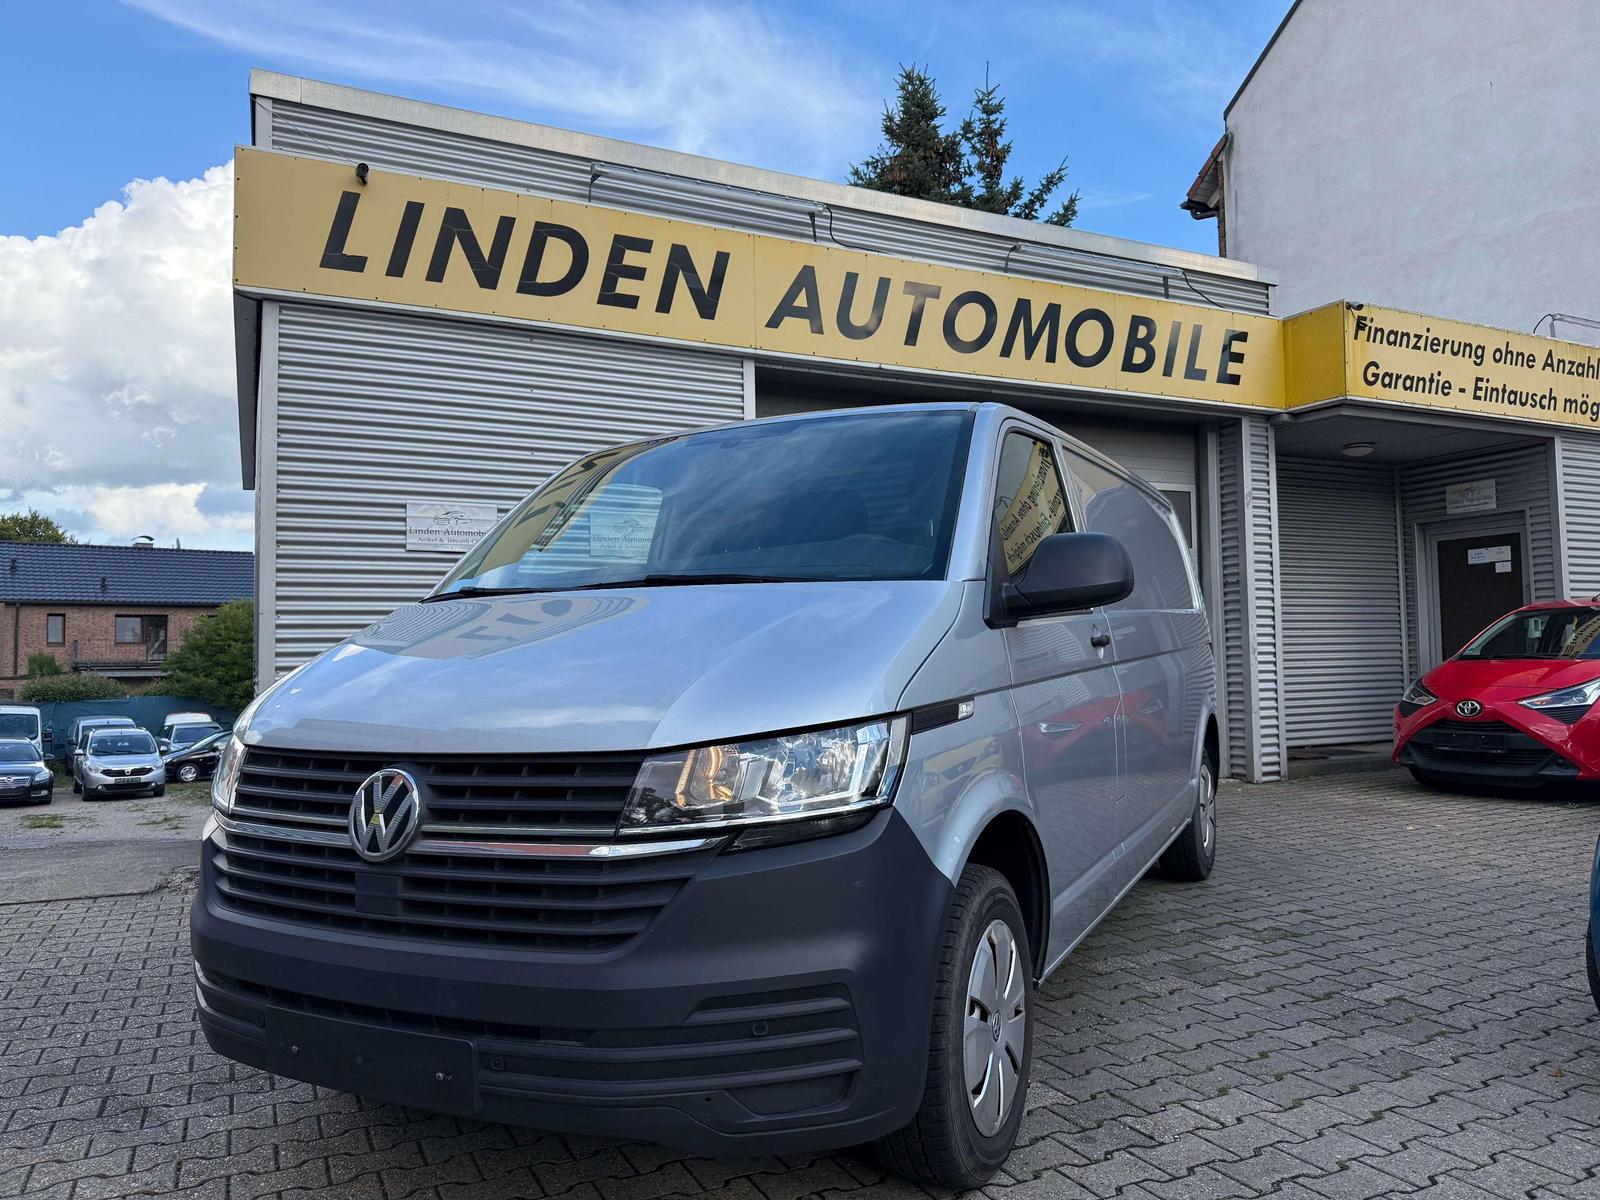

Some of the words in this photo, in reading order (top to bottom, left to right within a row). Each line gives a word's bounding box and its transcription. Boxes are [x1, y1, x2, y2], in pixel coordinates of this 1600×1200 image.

[319, 190, 731, 320] LINDEN
[764, 264, 1249, 386] AUTOMOBILE
[1353, 315, 1486, 367] Finanzierung
[1492, 342, 1536, 369] ohne
[1541, 349, 1600, 380] Anzahl
[1362, 360, 1453, 397] Garantie
[1472, 377, 1558, 411] Eintausch
[1562, 393, 1600, 422] mög
[409, 525, 440, 535] Linden
